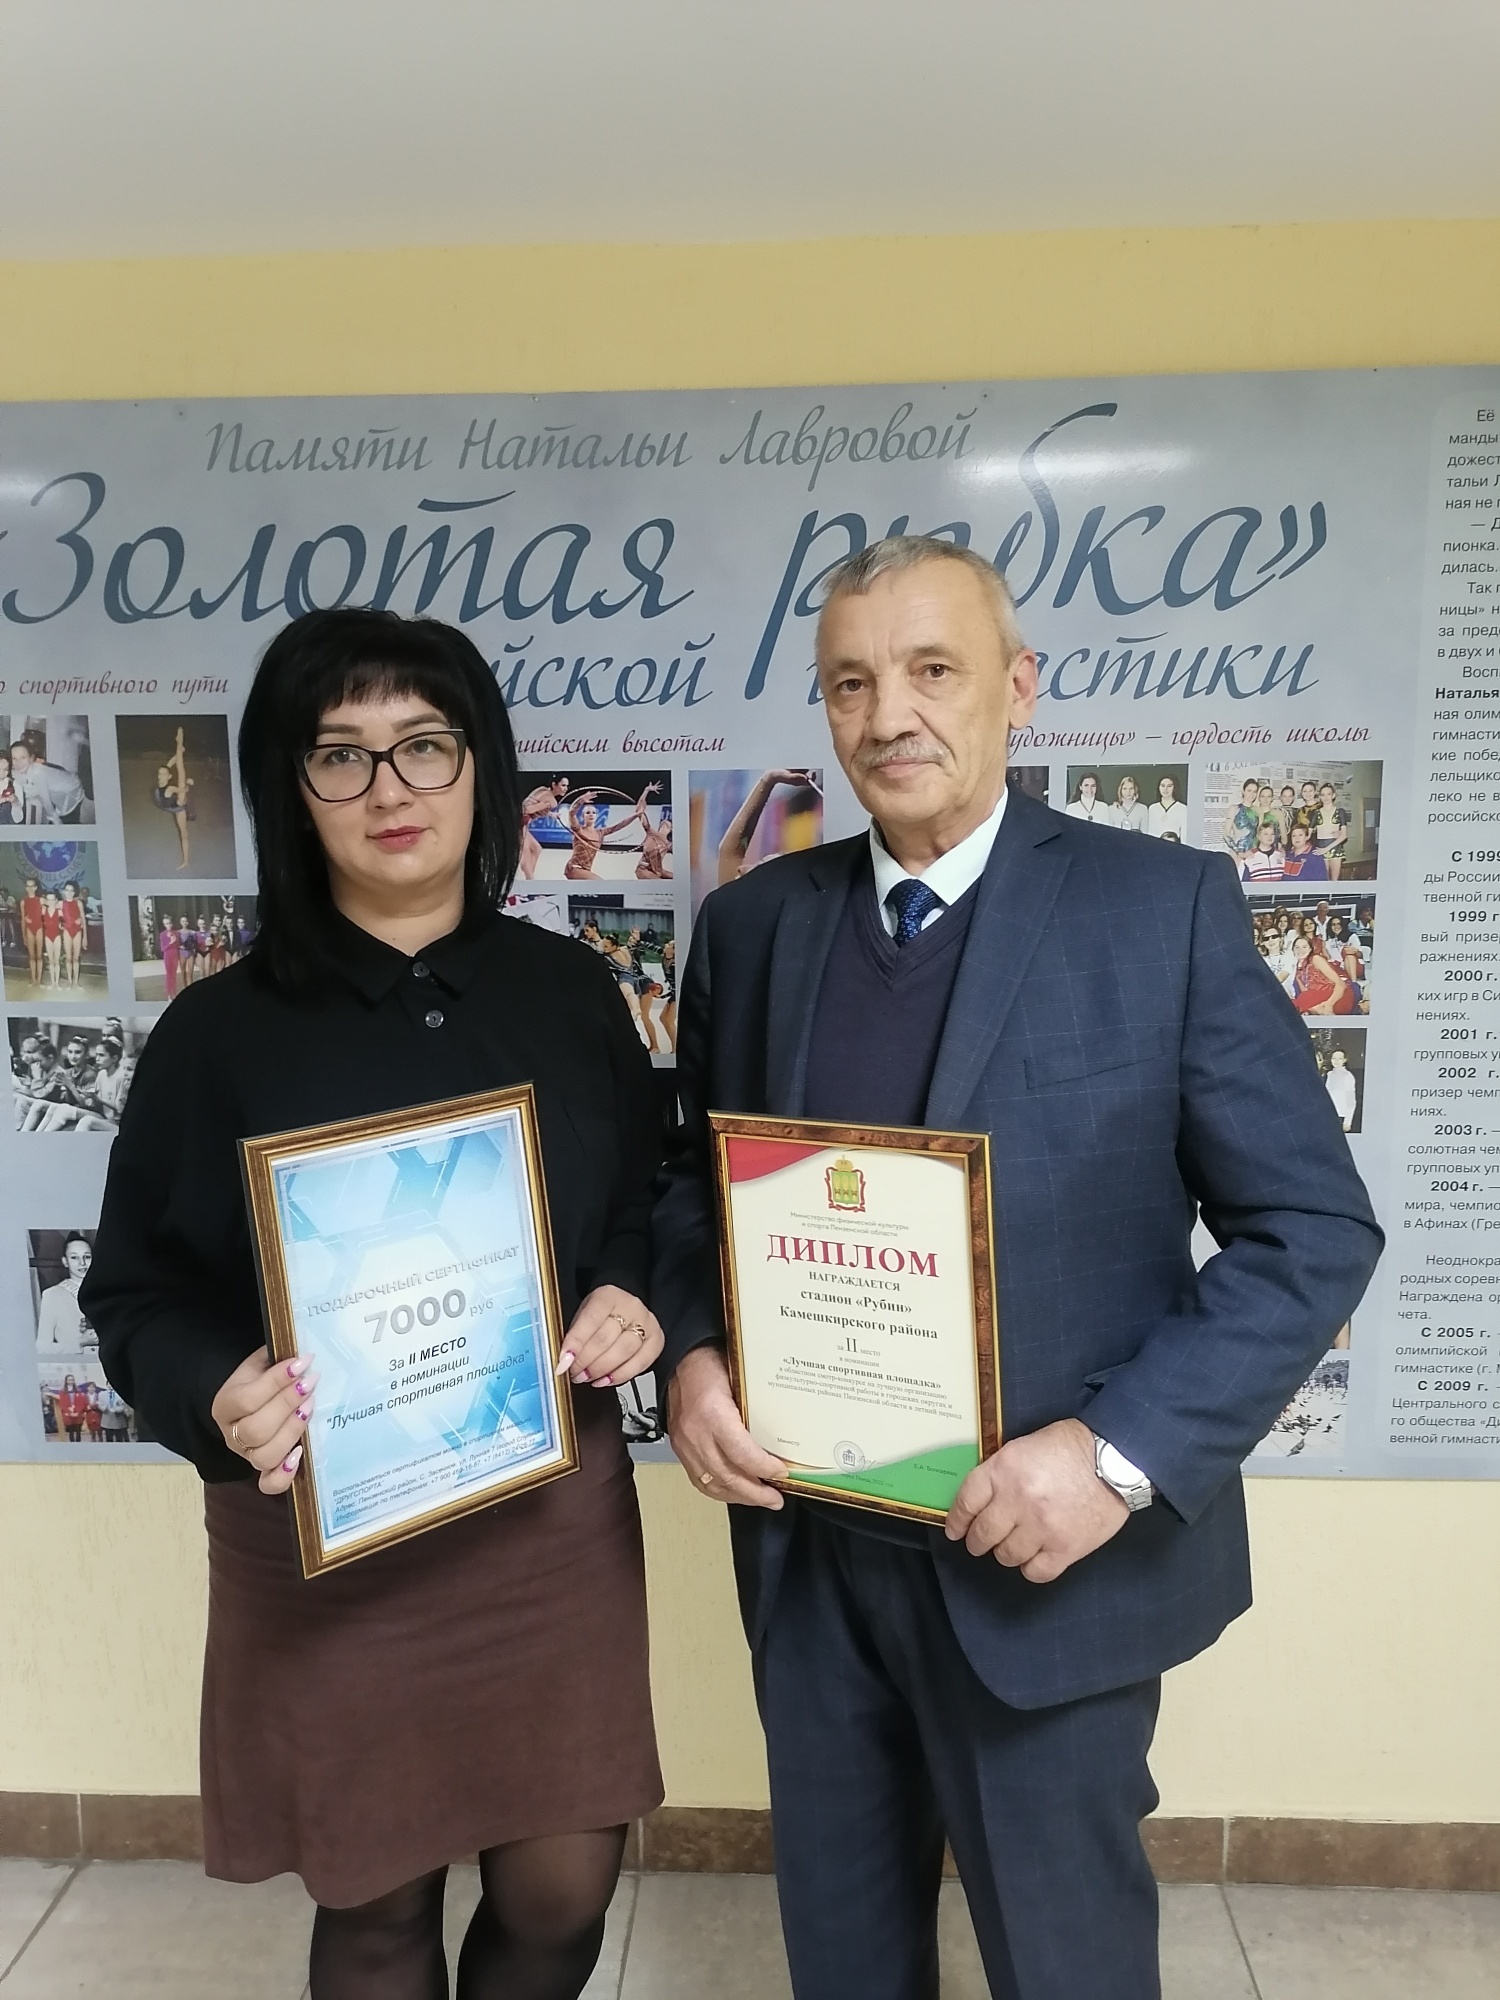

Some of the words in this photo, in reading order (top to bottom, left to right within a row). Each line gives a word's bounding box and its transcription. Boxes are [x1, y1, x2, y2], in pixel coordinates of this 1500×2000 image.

[1477, 409, 1494, 422] Её
[1449, 434, 1498, 445] манды
[206, 422, 432, 473] Памяти
[460, 418, 693, 471] Натальи
[720, 402, 977, 492] Лавровой
[1447, 478, 1488, 487] тальи
[1446, 500, 1471, 509] ная
[1475, 499, 1492, 508] не
[0, 471, 694, 625] Золотая
[744, 403, 1327, 700] рбка»
[1444, 542, 1499, 552] пионка.
[1441, 563, 1498, 575] дилась.
[1467, 582, 1492, 594] Так
[1440, 606, 1484, 617] ницы»
[1438, 627, 1454, 637] за
[1463, 627, 1500, 638] пред
[1438, 649, 1445, 657] в
[1448, 648, 1482, 660] двух
[1486, 648, 1494, 656] и
[1463, 666, 1500, 678] Восп
[19, 670, 158, 705] спортивного
[172, 674, 229, 704] пути
[1435, 688, 1499, 699] Наталья
[1434, 711, 1458, 720] ная
[622, 729, 726, 755] высотам
[1008, 724, 1136, 759] удожницы»
[1171, 722, 1273, 756] гордость
[1286, 725, 1372, 746] школы
[1432, 752, 1456, 761] кие
[1464, 749, 1500, 762] побе
[1429, 793, 1462, 802] леко
[1469, 793, 1486, 801] не
[1452, 851, 1462, 862] С
[1424, 874, 1444, 884] ды
[1448, 871, 1500, 882] России
[1423, 891, 1482, 902] твенной
[1449, 911, 1486, 922] 1999
[1421, 931, 1448, 942] вый
[1456, 933, 1500, 944] призе
[1444, 970, 1483, 981] 2000
[1487, 973, 1497, 981] г.
[1444, 993, 1468, 1003] игр
[1416, 1012, 1470, 1020] нениях.
[1440, 1029, 1476, 1039] 2001
[1414, 1051, 1488, 1061] групповых
[1438, 1068, 1476, 1078] 2002
[1488, 1070, 1499, 1078] г.
[1412, 1089, 1462, 1099] призер
[1411, 1108, 1446, 1116] ниях.
[1434, 1125, 1472, 1135] 2003
[1408, 1146, 1475, 1154] солютная
[1407, 1165, 1480, 1175] групповых
[1431, 1181, 1468, 1191] 2004
[1405, 1202, 1444, 1212] мира,
[1404, 1220, 1411, 1228] в
[1414, 1218, 1467, 1230] Афинах
[1471, 1219, 1500, 1231] (Гре
[767, 1234, 939, 1278] ДИПЛОМ
[1426, 1255, 1500, 1268] Неоднокра
[307, 1273, 422, 1317] ПОДАРОЧНЫЙ
[424, 1245, 520, 1282] СЕРТИФИКАТ
[809, 1271, 901, 1292] НАГРАЖДАЕТСЯ
[1400, 1275, 1452, 1285] родных
[800, 1289, 852, 1305] стадион
[855, 1296, 912, 1314] «Рубин»
[1399, 1291, 1483, 1303] Награждена
[364, 1288, 467, 1344] 7000
[469, 1299, 494, 1318] руб
[1398, 1311, 1431, 1319] чета.
[780, 1305, 886, 1332] Камешкирского
[889, 1322, 938, 1340] района
[1421, 1327, 1431, 1337] С
[1437, 1327, 1474, 1337] 2005
[389, 1358, 405, 1372] За
[420, 1336, 467, 1362] МЕСТО
[860, 1348, 881, 1357] место
[1396, 1346, 1487, 1356] олимпийской
[390, 1380, 398, 1390] в
[402, 1355, 470, 1388] номинации
[783, 1355, 826, 1371] «Лучшая
[828, 1363, 883, 1381] спортивная
[886, 1373, 942, 1390] площадка»
[1394, 1365, 1473, 1373] гимнастике
[1477, 1364, 1492, 1375] (г.
[326, 1401, 383, 1430] "Лучшая
[387, 1374, 463, 1410] спортивная
[466, 1350, 530, 1382] площадка"
[1418, 1381, 1427, 1390] С
[1434, 1381, 1470, 1391] 2009
[1393, 1398, 1487, 1410] Центрального
[1410, 1416, 1475, 1427] общества
[1390, 1434, 1437, 1443] венной
